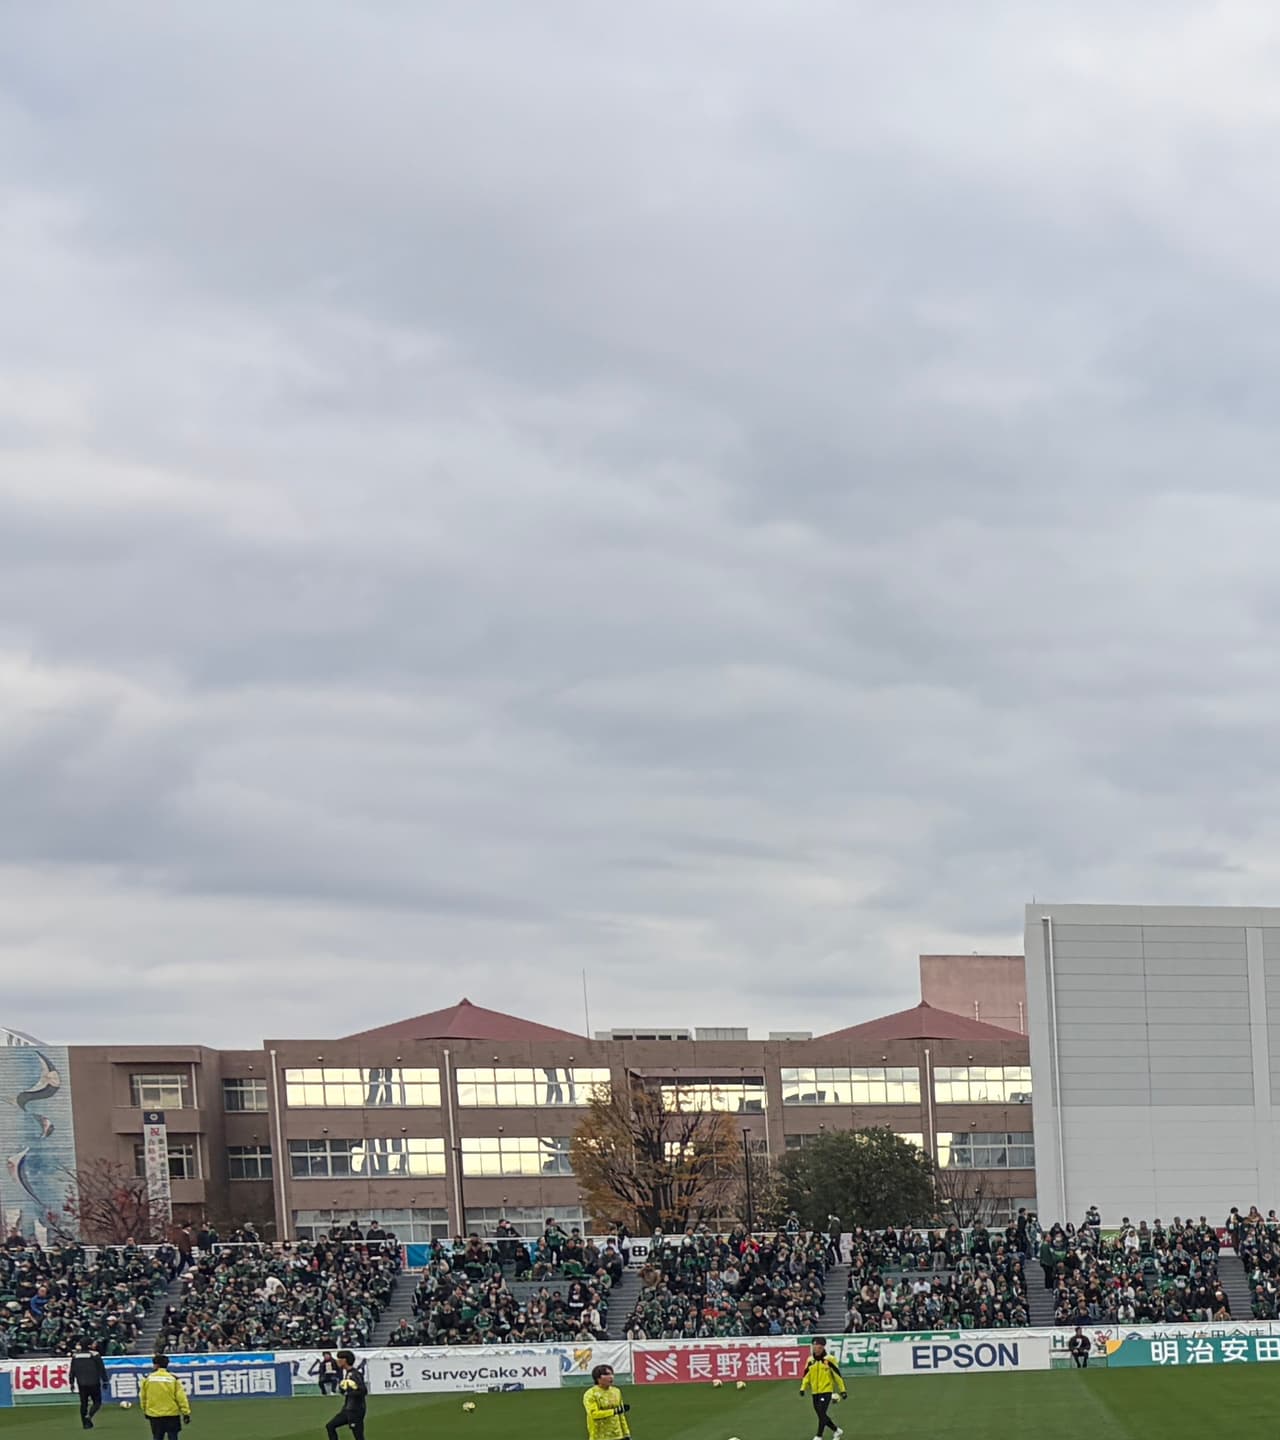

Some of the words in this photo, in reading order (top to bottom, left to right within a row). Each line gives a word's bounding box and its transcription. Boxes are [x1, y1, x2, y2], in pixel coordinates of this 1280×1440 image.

[686, 1351, 800, 1379] 長野銀行
[912, 1342, 1019, 1370] EPSON
[422, 1365, 518, 1382] SurveyCake
[522, 1365, 547, 1378] XM
